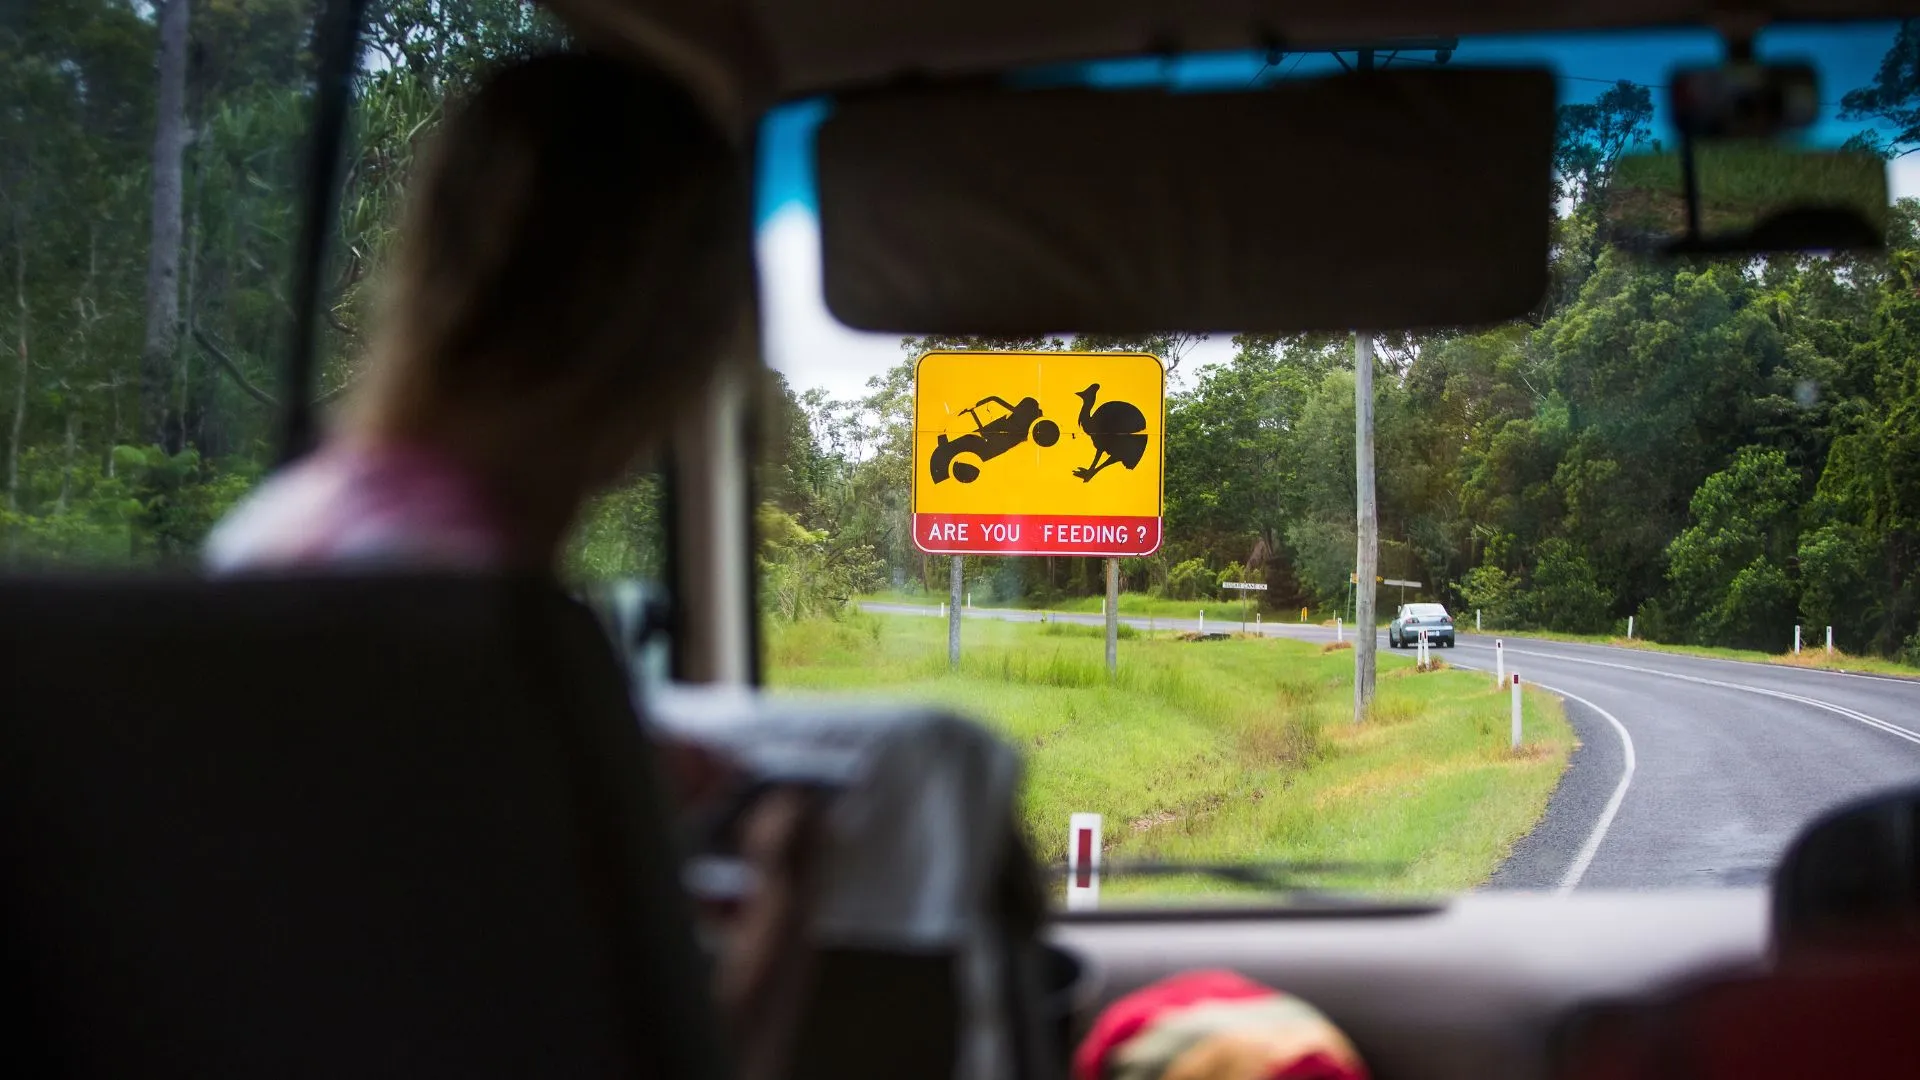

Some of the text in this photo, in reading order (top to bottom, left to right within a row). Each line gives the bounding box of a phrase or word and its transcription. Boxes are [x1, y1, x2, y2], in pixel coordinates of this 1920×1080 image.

[928, 523, 1147, 544] ARE YOU FEEDING ?
